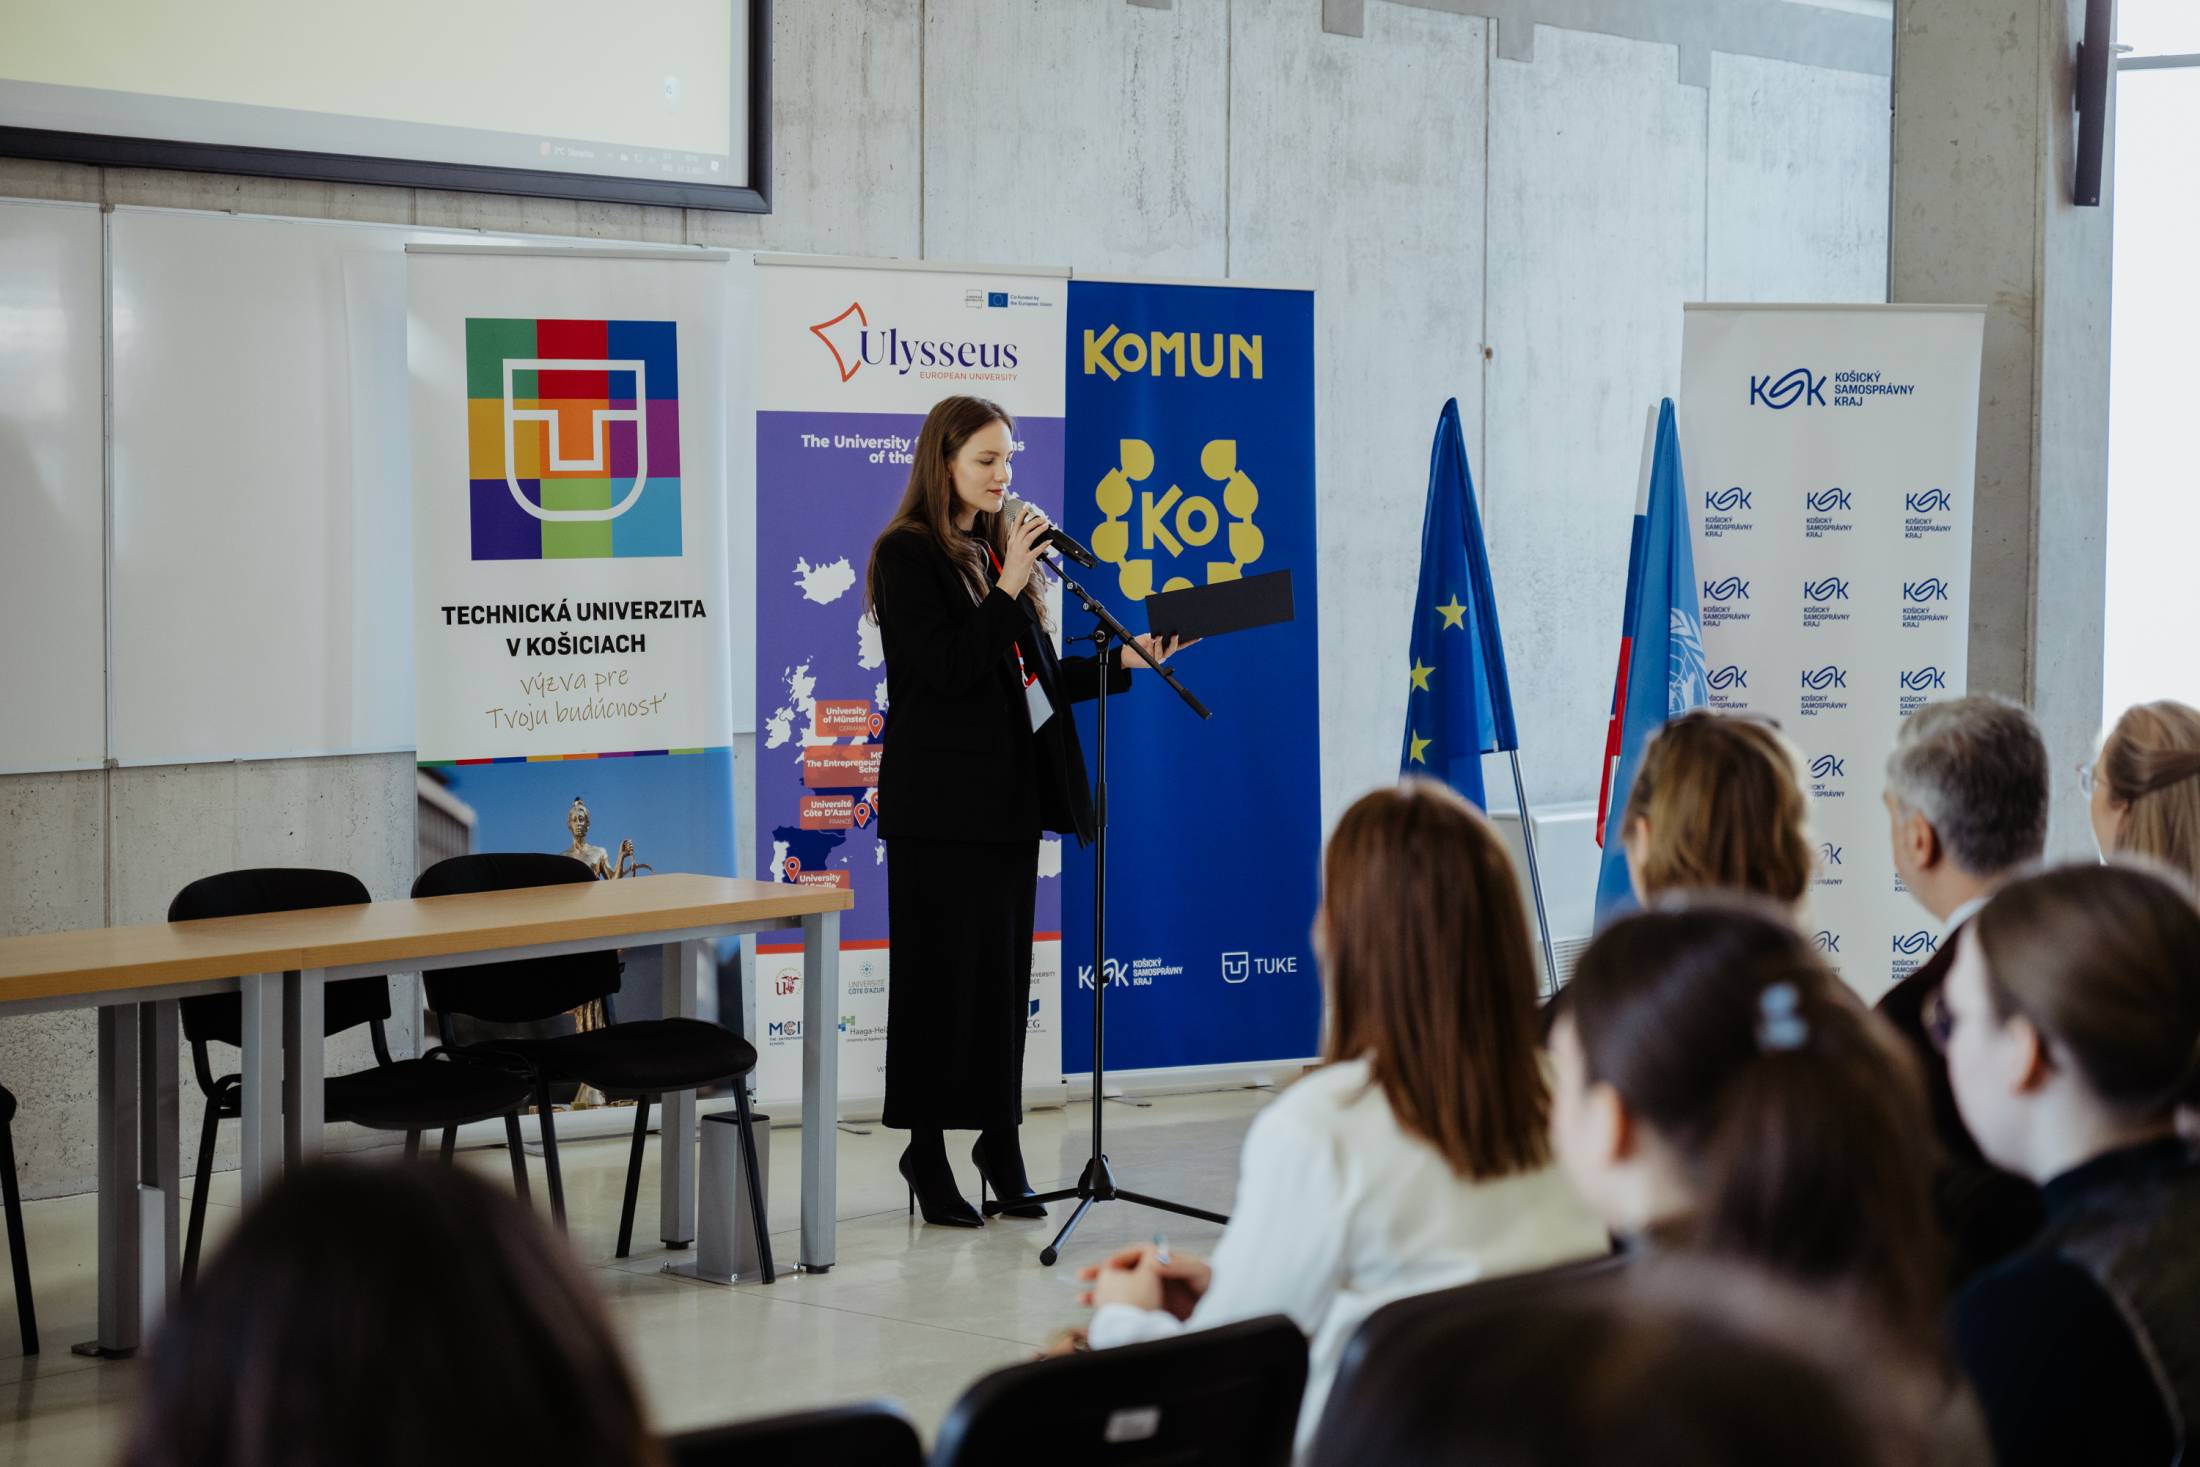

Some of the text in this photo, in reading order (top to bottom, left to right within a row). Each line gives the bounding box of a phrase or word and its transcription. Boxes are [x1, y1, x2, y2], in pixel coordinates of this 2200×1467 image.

[860, 328, 1018, 375] Ulysseus
[1084, 324, 1262, 382] KOMUN
[920, 371, 1018, 382] EUROPEAN UNIVERSITY
[1835, 370, 1881, 382] KOŠICKÝ
[1834, 382, 1914, 395] SAMOSPRÁVNY
[1834, 397, 1863, 406] KRAJ
[801, 434, 830, 448] The
[834, 435, 911, 452] University
[869, 450, 914, 464] of the
[1142, 484, 1219, 558] KO
[442, 598, 706, 626] TECHNICKÁ UNIVERZITA
[506, 632, 646, 656] V KOŠICIACH
[595, 669, 629, 692] pre
[486, 692, 667, 731] Tvoju budúcnosť
[826, 706, 867, 716] University
[807, 760, 822, 768] The
[811, 800, 852, 808] Université
[804, 809, 822, 817] Côte
[800, 874, 840, 882] University
[1133, 957, 1162, 968] KOŠICKÝ
[1254, 957, 1297, 974] TUKE
[1133, 966, 1184, 977] SAMOSPRÁVNY
[1133, 978, 1152, 986] KRAJ
[769, 1021, 800, 1036] MCI
